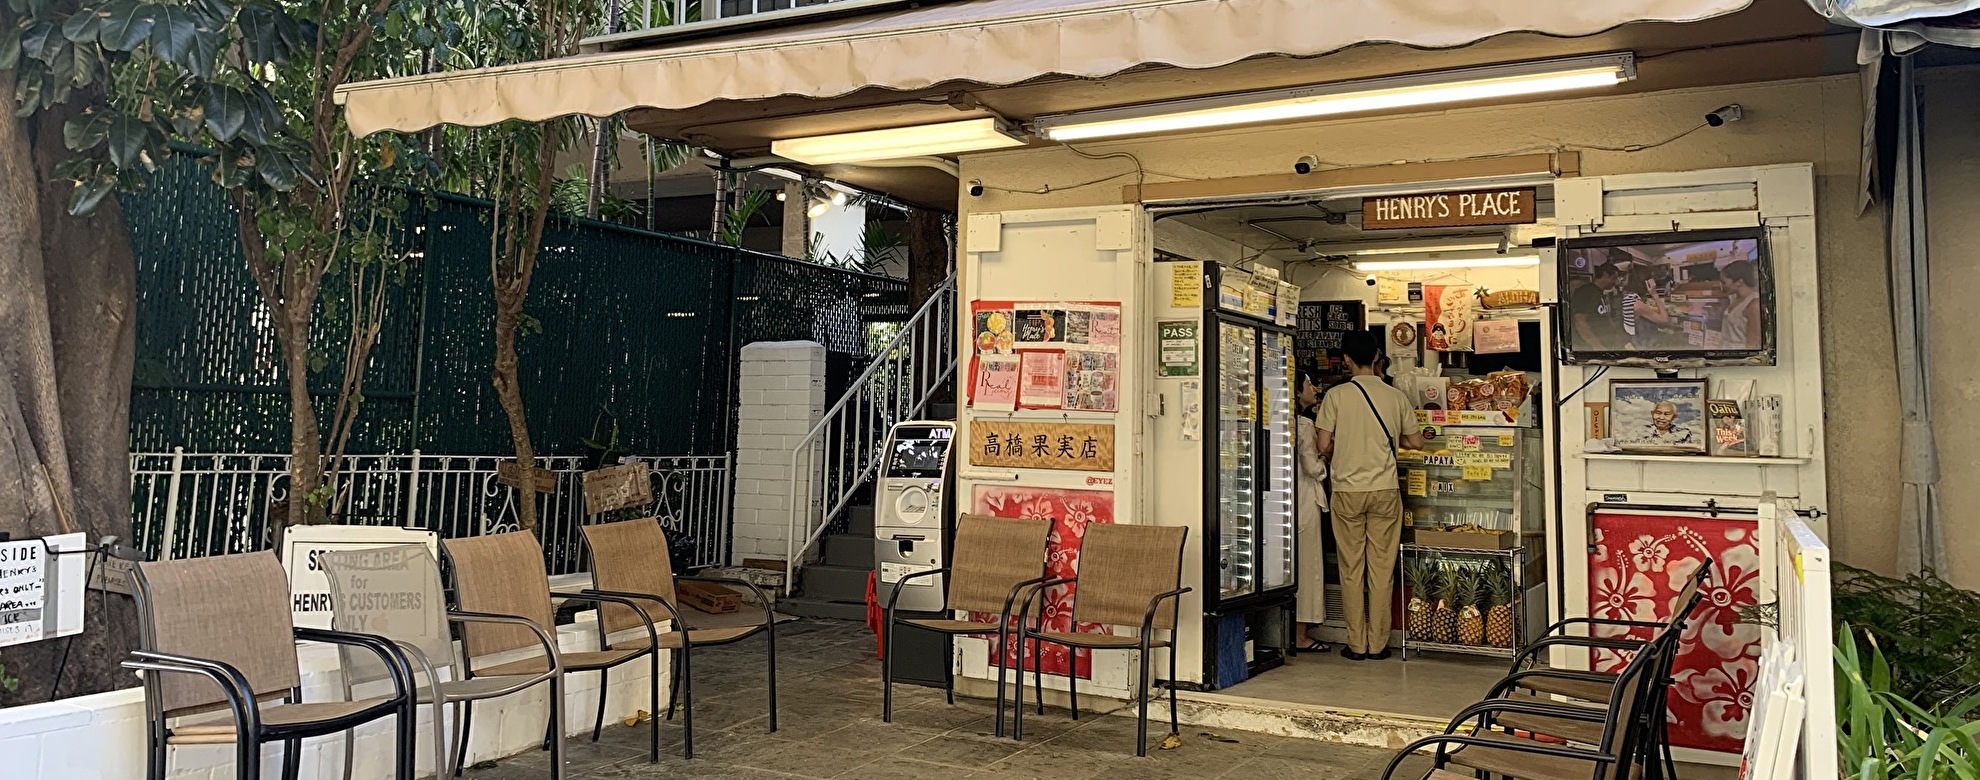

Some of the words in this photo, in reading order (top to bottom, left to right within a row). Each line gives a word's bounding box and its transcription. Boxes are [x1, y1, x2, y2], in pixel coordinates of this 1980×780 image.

[1376, 194, 1450, 221] HENRY'S
[1459, 190, 1521, 219] PLACE
[1498, 290, 1537, 305] ALOHA
[1163, 328, 1193, 338] PASS
[980, 371, 1012, 390] Real
[1709, 403, 1738, 414] Oahu
[928, 428, 951, 439] ATM
[1715, 428, 1733, 436] This
[1715, 435, 1738, 443] Week
[983, 431, 1099, 459] 高橋果実店
[1423, 455, 1455, 465] PAPAYA
[308, 549, 369, 572] SETING
[373, 549, 409, 571] AREA
[350, 574, 369, 590] for
[293, 591, 346, 612] HENRYS
[350, 591, 422, 611] CUSTOMERS
